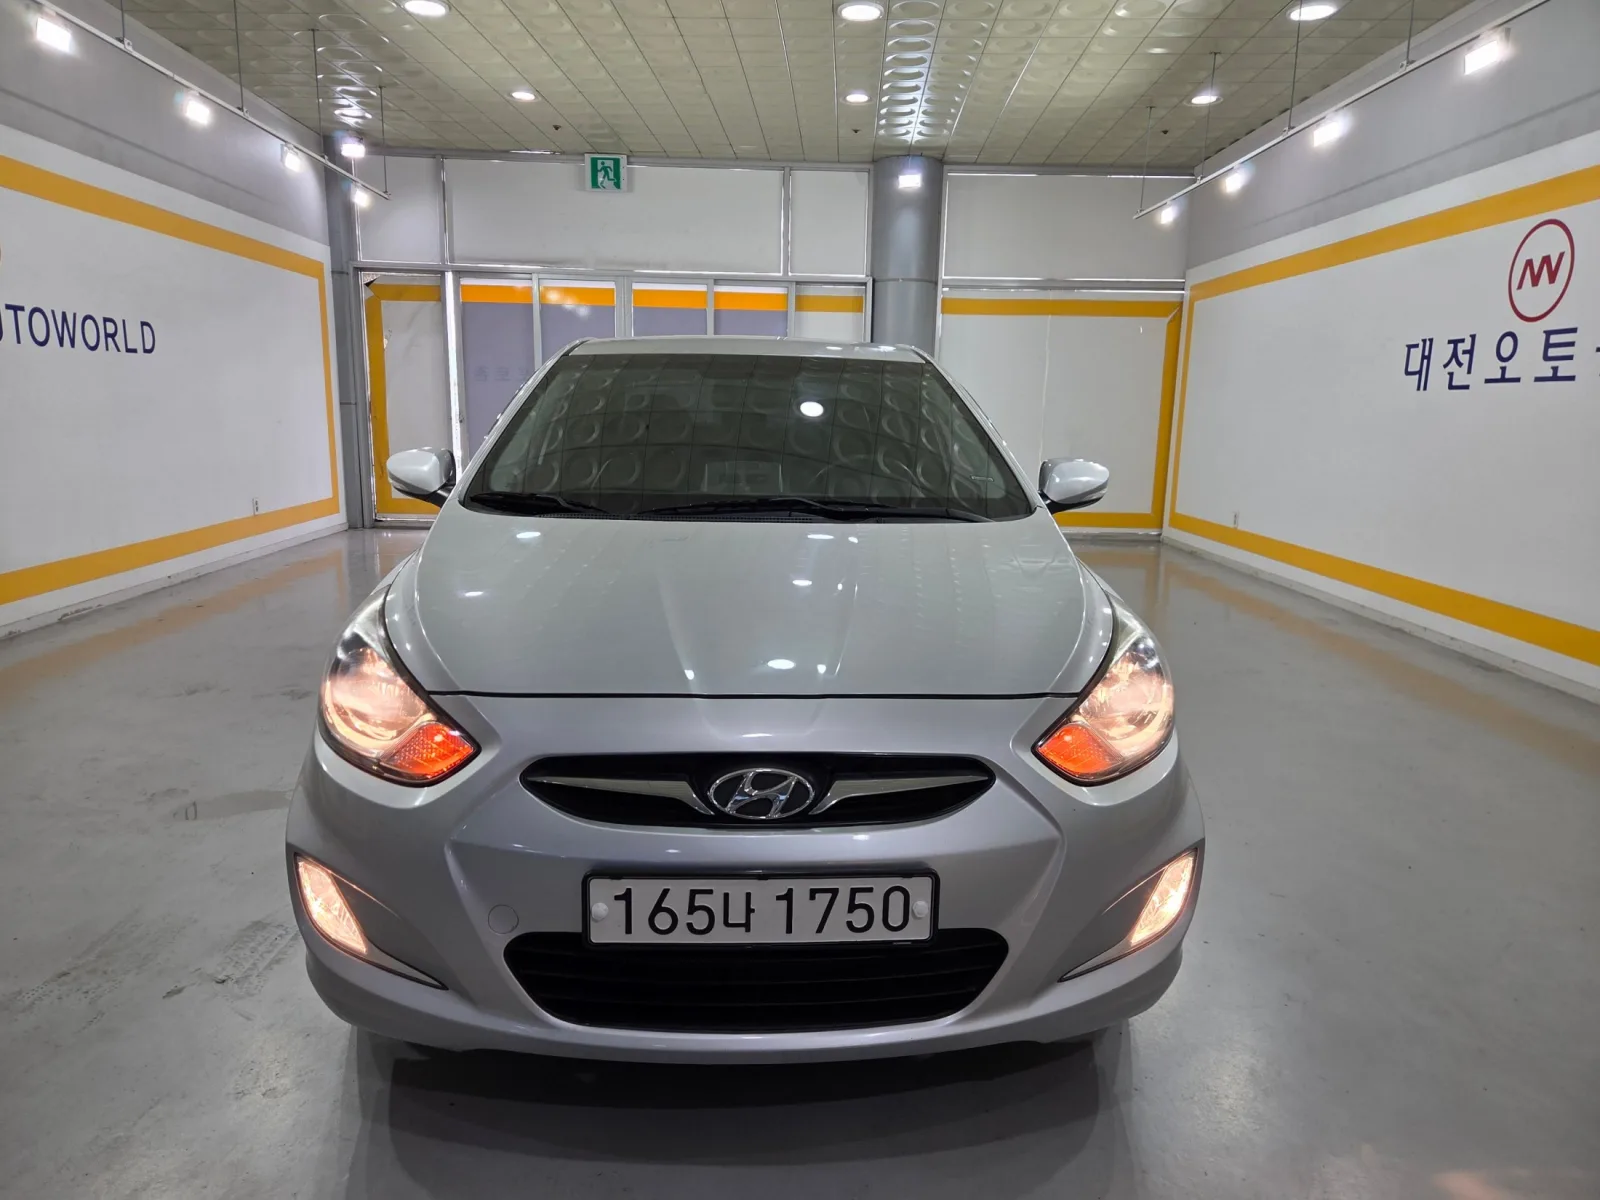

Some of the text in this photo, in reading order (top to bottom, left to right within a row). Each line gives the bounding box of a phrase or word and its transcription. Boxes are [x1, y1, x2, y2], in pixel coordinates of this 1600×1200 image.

[0, 303, 156, 354] TOWORLD
[1404, 326, 1600, 391] 대전오토
[613, 885, 911, 935] 165나 1750
